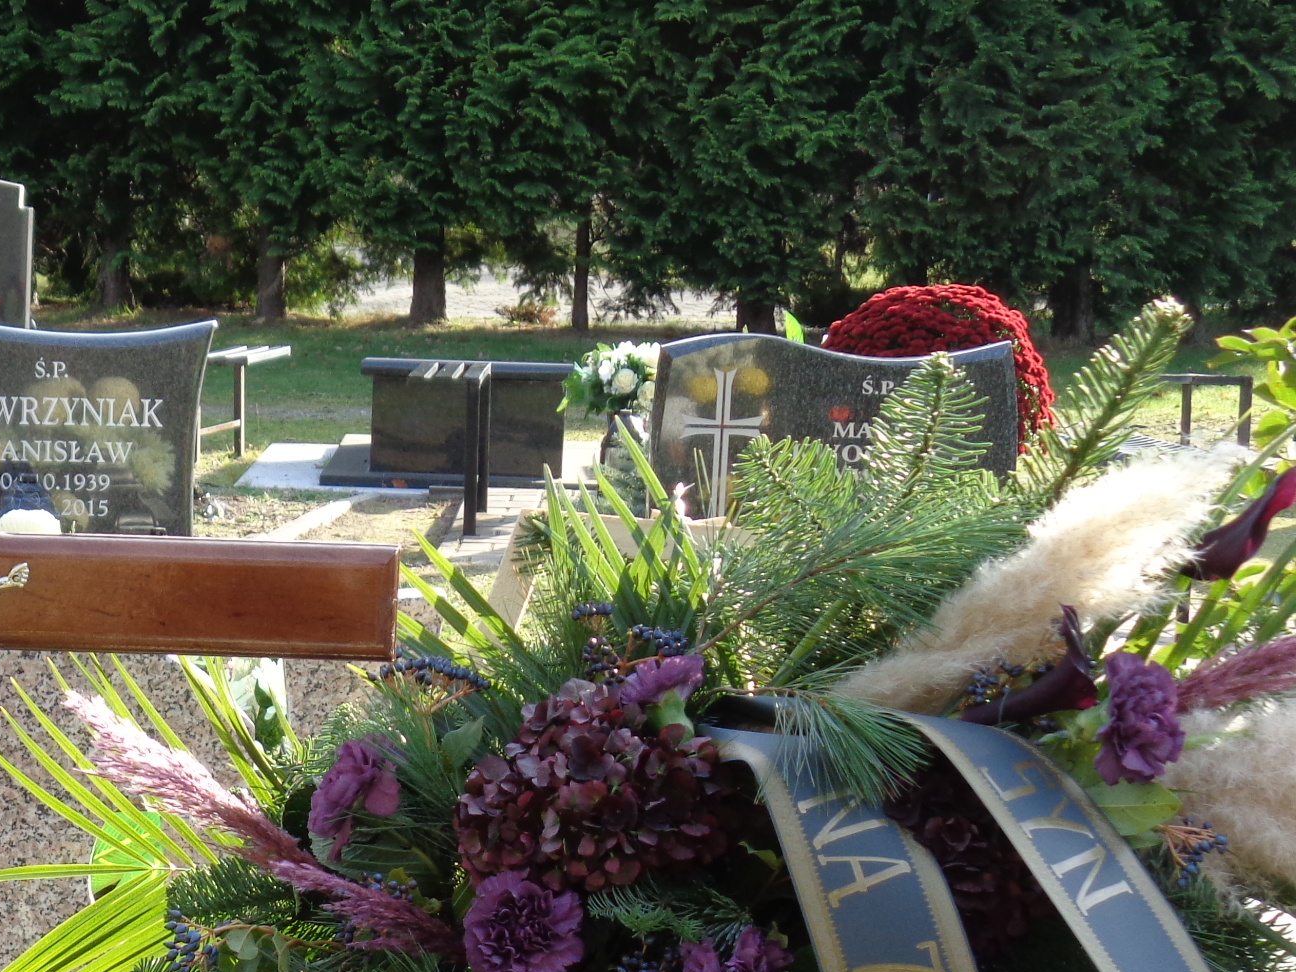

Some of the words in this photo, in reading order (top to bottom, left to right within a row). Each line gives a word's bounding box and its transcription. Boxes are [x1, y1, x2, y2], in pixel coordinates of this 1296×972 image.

[35, 356, 69, 378] Ś.P.
[797, 788, 911, 908] NA
[979, 760, 1133, 916] SYN
